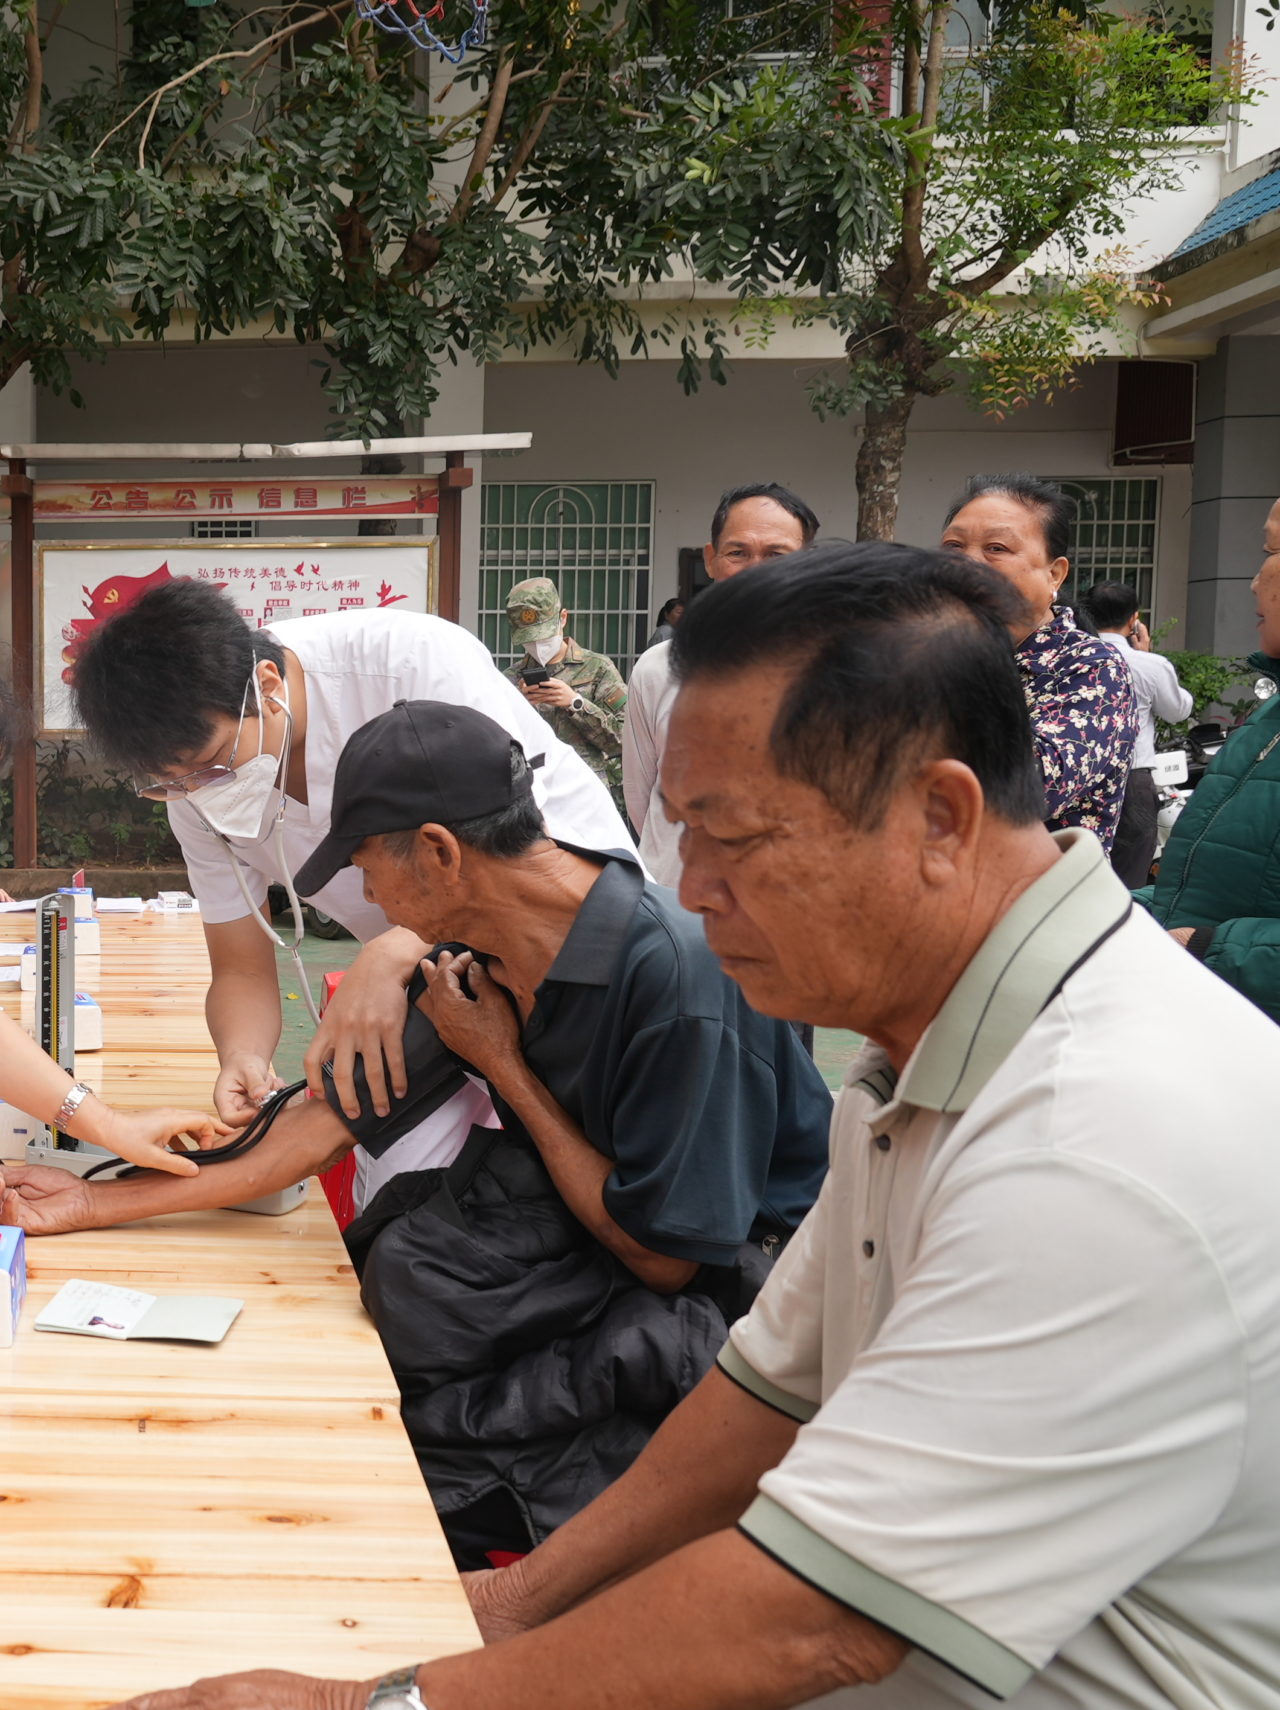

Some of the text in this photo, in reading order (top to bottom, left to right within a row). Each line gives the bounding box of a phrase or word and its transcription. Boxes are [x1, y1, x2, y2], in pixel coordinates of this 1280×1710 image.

[89, 487, 368, 510] 公告公示信息栏
[197, 567, 288, 580] 弘扬传统美德
[269, 580, 361, 592] 倡导时代精神
